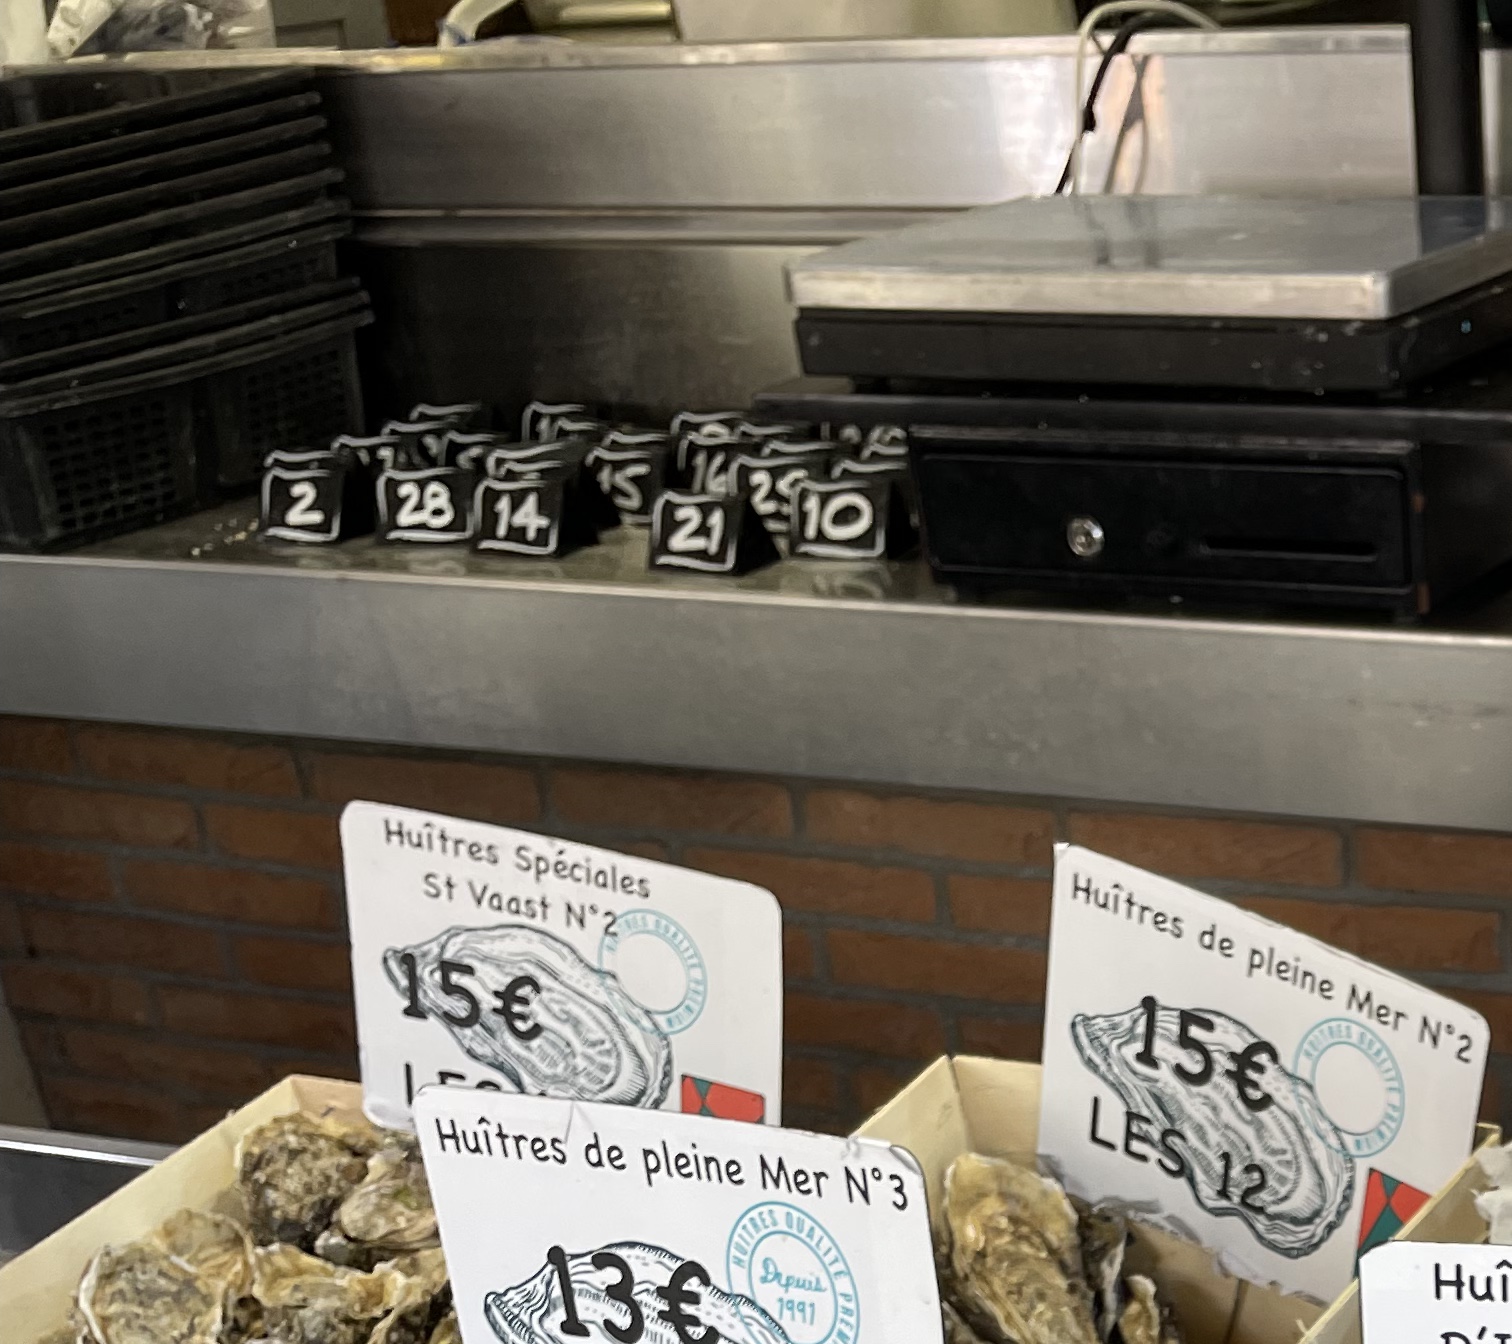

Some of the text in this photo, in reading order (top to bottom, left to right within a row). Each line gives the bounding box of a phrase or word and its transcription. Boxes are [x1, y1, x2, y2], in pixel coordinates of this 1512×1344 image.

[285, 481, 325, 526] 2
[397, 481, 455, 528] 28
[494, 492, 549, 541] 14
[803, 491, 874, 541] 10
[668, 505, 725, 556] 21
[383, 818, 652, 899] Huîtres Spéciales
[422, 873, 457, 901] St
[468, 881, 550, 922] Vaast
[1072, 873, 1185, 939] Huîtres
[1199, 923, 1235, 958] de
[1247, 945, 1335, 1001] pleine
[1345, 983, 1408, 1031] Mer
[436, 1116, 568, 1165] Huîtres
[585, 1133, 627, 1172] de
[643, 1141, 745, 1188] pleine
[759, 1154, 829, 1200] Mer
[1089, 1096, 1269, 1216] LES 12
[777, 1297, 816, 1327] 1991
